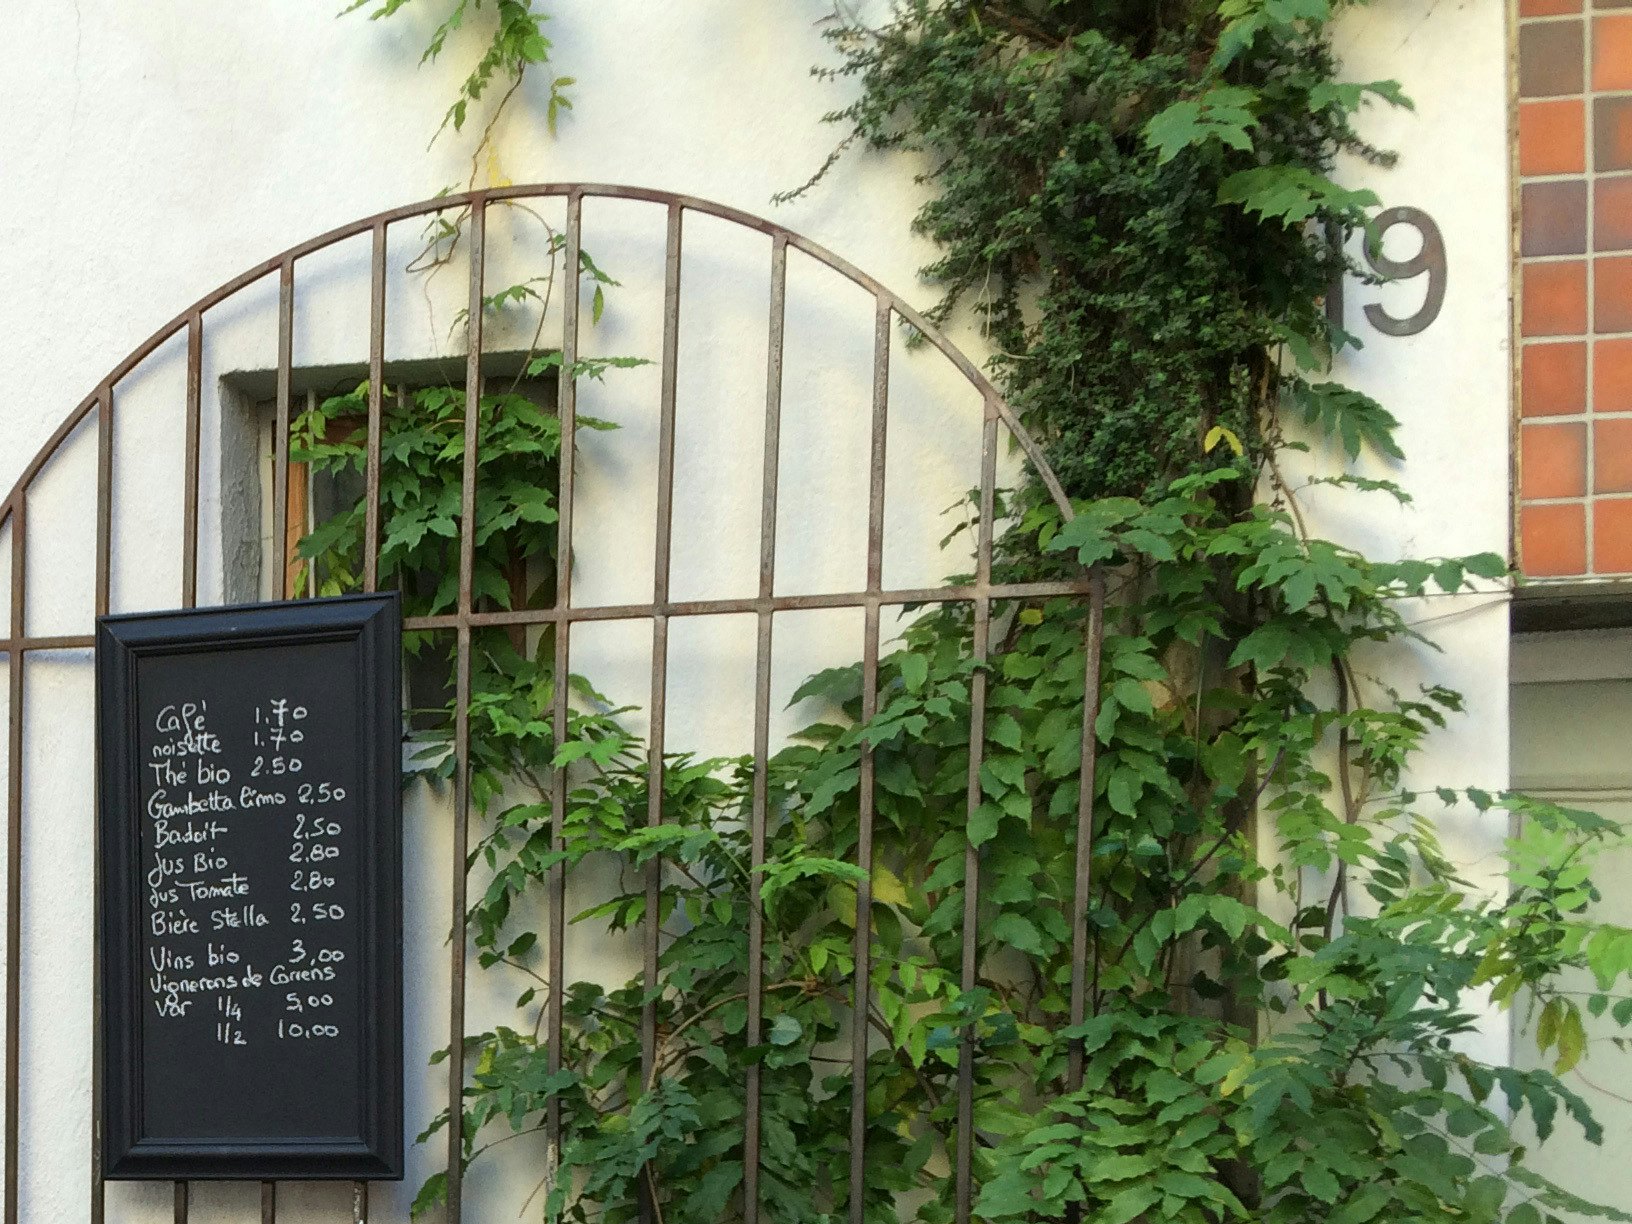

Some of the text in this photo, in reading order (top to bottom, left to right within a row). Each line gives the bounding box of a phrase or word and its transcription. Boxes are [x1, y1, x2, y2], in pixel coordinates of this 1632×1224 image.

[156, 698, 308, 743] Café 1.70
[152, 727, 304, 757] noisette 1.70
[149, 758, 188, 787] Thé
[197, 758, 231, 785] bio
[147, 788, 237, 819] Gambetta
[154, 819, 228, 848] Badoit
[193, 847, 228, 873] Bio
[175, 872, 250, 901] Tomate
[151, 909, 200, 936] Bière
[211, 904, 269, 930] Stella
[150, 946, 194, 972] Vins
[208, 943, 239, 967] bio
[150, 973, 238, 1006] Vignerons
[242, 965, 263, 988] de
[218, 995, 242, 1021] 1/4
[218, 1022, 247, 1045] 1/2
